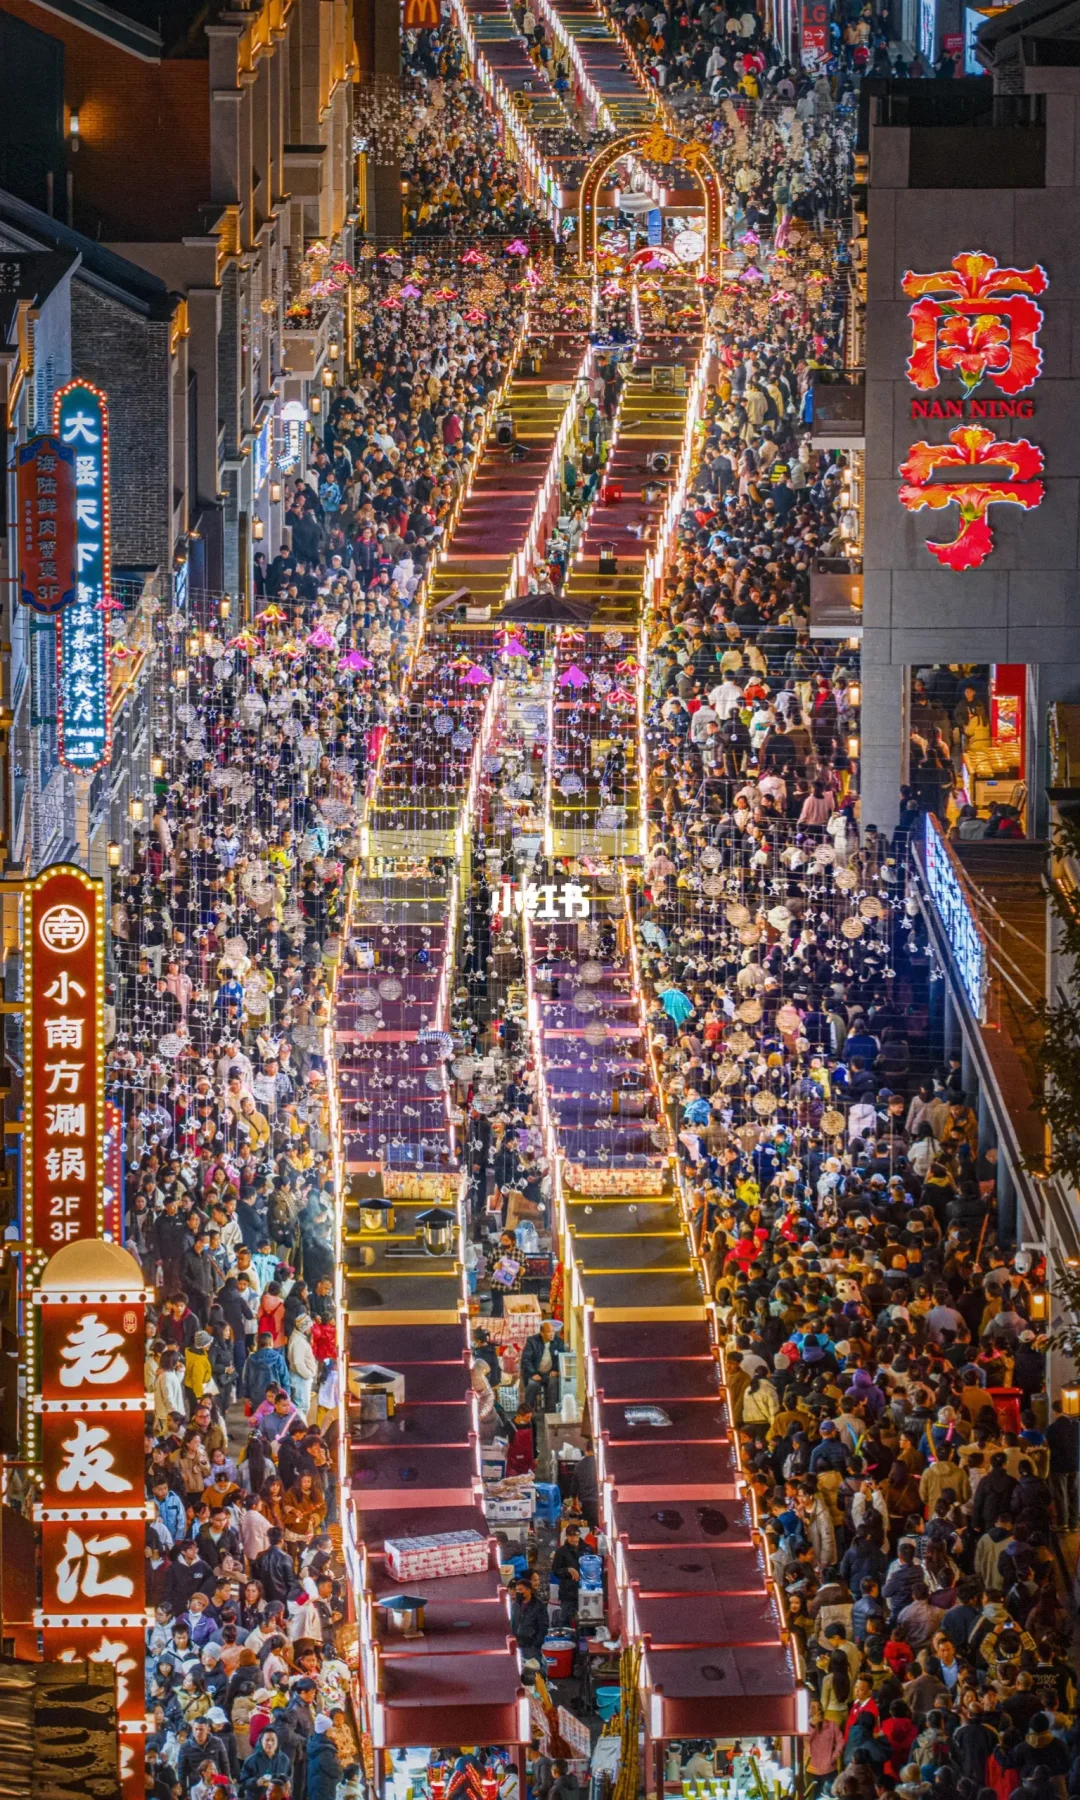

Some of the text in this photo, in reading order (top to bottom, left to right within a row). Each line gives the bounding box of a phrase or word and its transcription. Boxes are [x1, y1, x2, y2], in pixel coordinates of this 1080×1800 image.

[911, 399, 1035, 419] NAN NING
[43, 971, 87, 1182] 小南方涮锅
[50, 1197, 80, 1217] 2F
[50, 1221, 80, 1242] 3F
